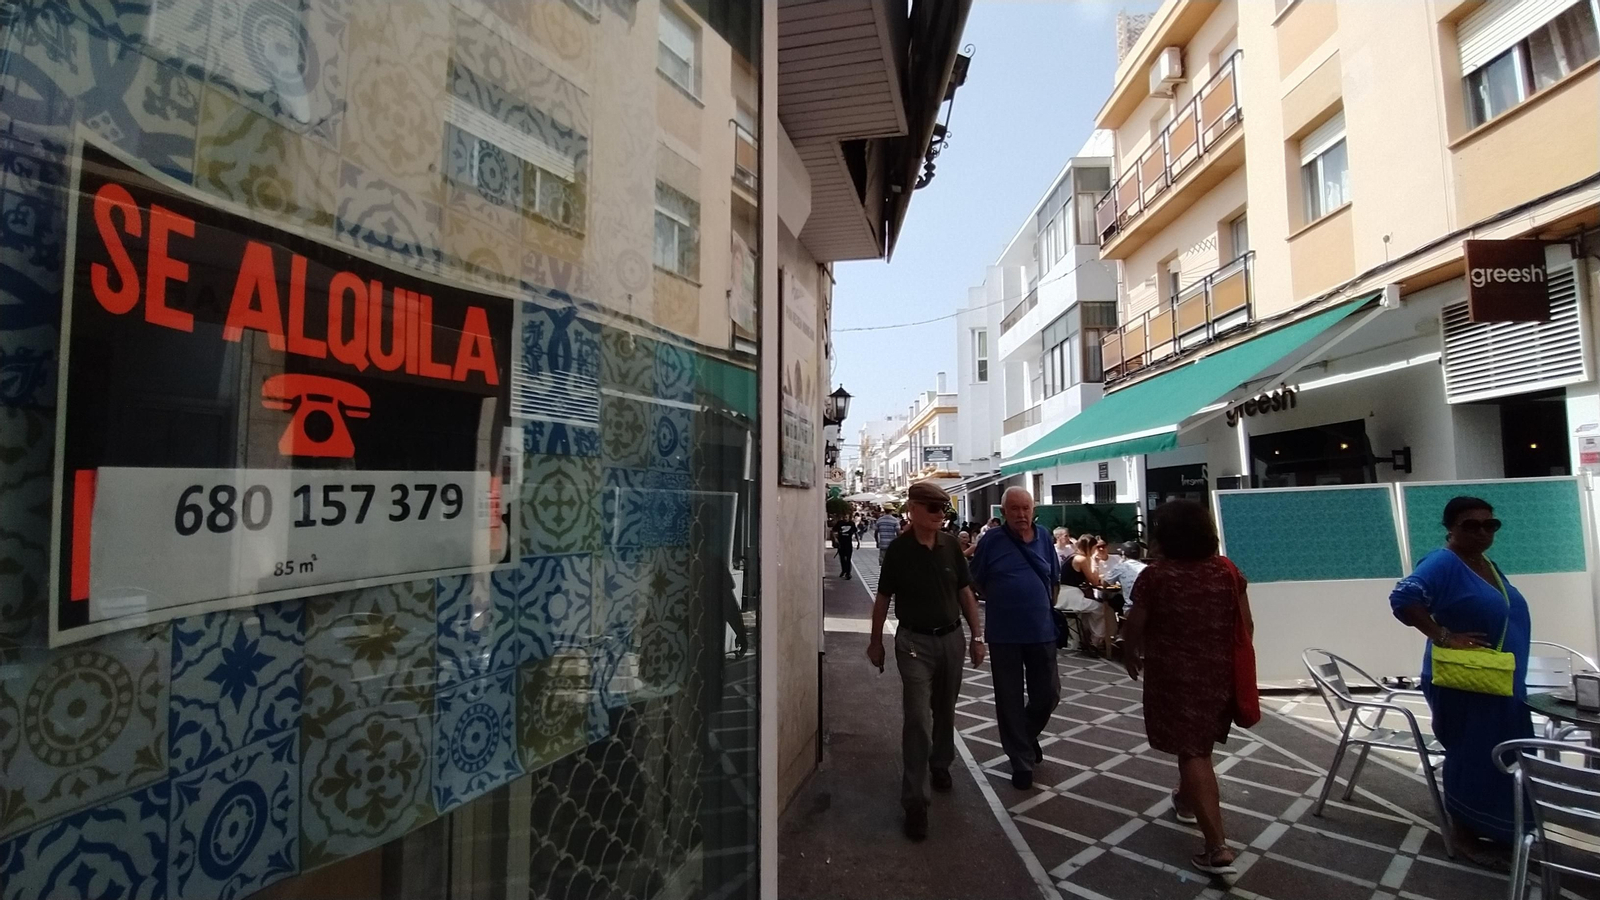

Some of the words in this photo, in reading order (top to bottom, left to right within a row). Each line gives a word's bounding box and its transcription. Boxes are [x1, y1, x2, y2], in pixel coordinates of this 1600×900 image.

[91, 183, 195, 332] SE
[222, 241, 499, 385] ALQUILA
[1471, 264, 1544, 288] greesh
[174, 484, 273, 537] 680
[293, 484, 376, 528] 157
[388, 483, 464, 523] 379
[273, 560, 295, 577] 85
